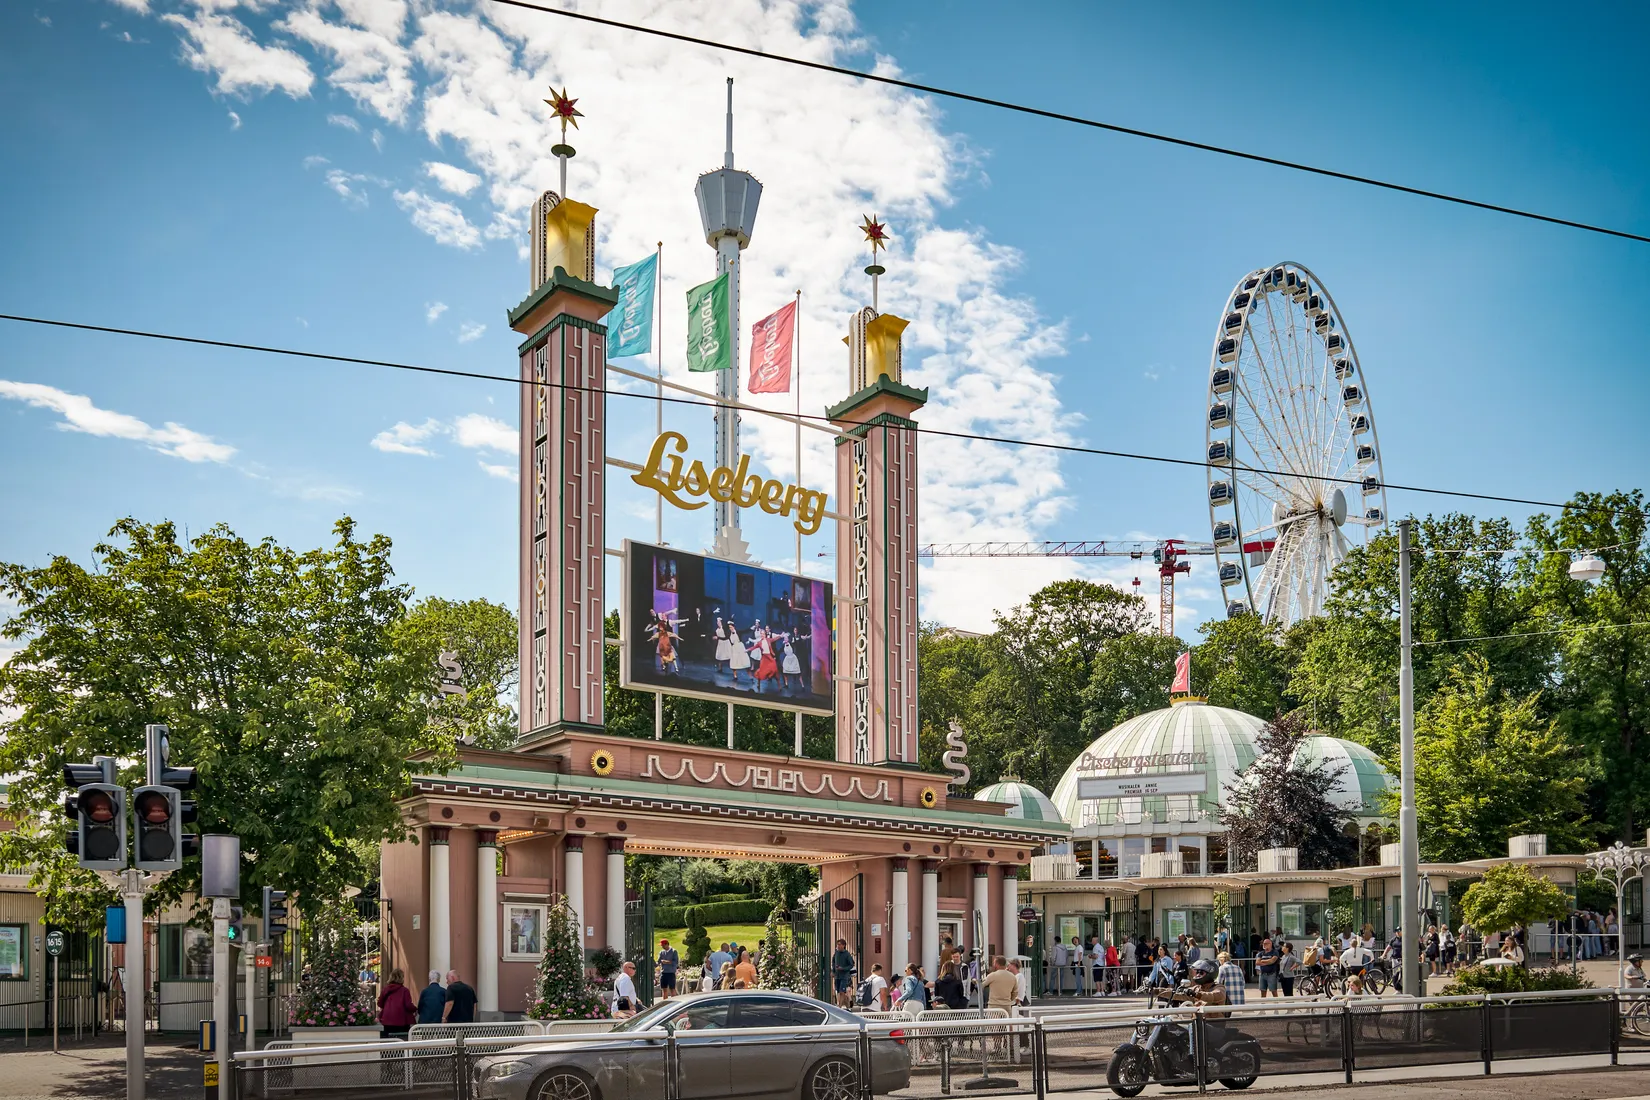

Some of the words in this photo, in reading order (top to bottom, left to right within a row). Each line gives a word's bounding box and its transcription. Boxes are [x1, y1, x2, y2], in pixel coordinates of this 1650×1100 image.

[630, 431, 828, 535] Liseberg
[1076, 750, 1208, 773] Lisebergsteatern
[54, 938, 62, 946] 15
